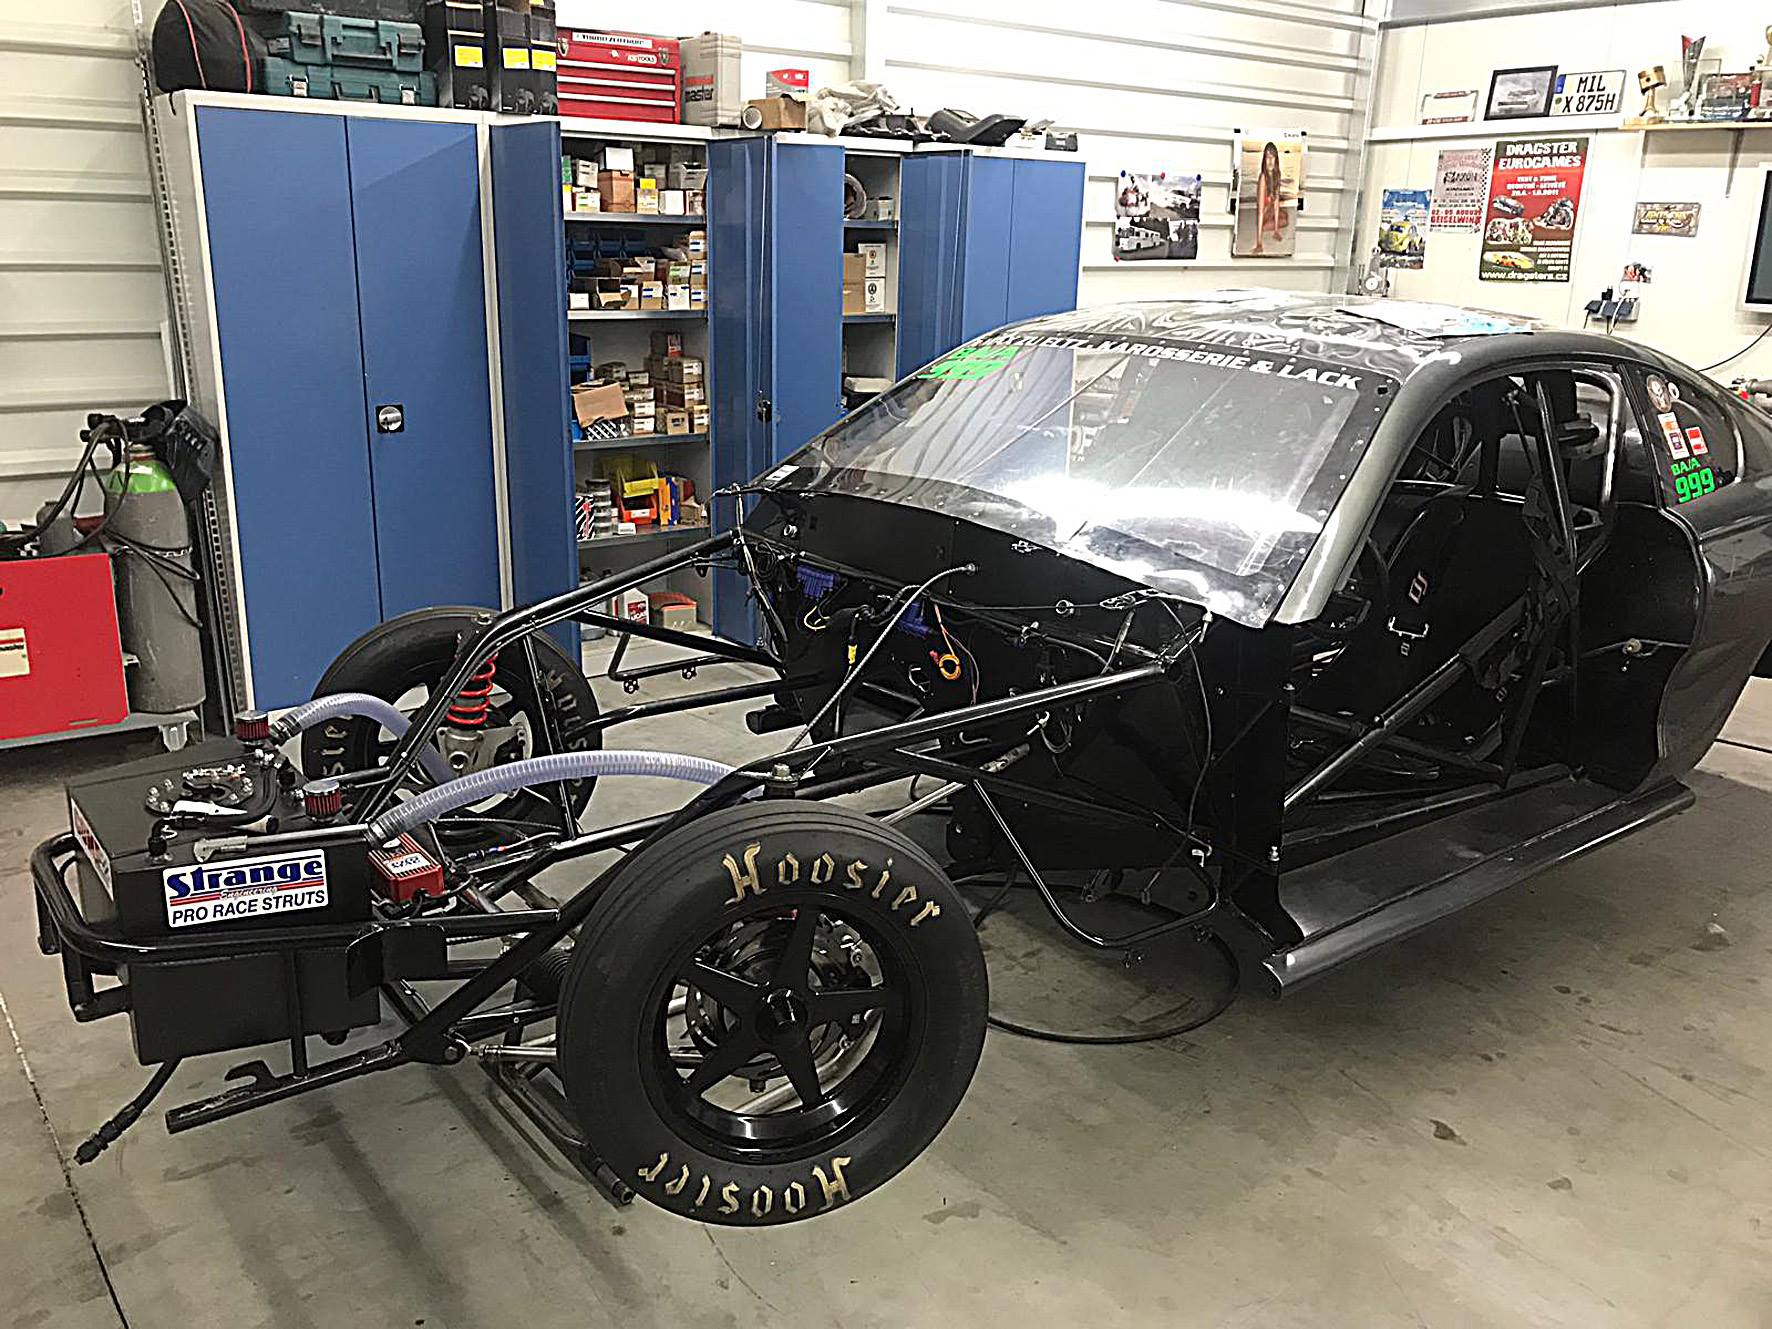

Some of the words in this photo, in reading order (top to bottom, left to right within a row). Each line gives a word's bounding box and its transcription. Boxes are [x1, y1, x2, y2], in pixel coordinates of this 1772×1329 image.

[1576, 75, 1606, 93] MIL
[1562, 96, 1573, 113] X
[1575, 93, 1616, 112] 875H
[1498, 155, 1582, 171] EUROGAMES
[1505, 142, 1578, 156] DRAGSTER
[1481, 270, 1568, 281] www.dragsters.cz
[1098, 340, 1250, 371] KAROSSERIE
[1249, 360, 1275, 375] &
[1276, 364, 1362, 391] LACK
[1675, 467, 1716, 503] 999
[166, 859, 323, 899] Strange
[722, 842, 940, 927] Hoosier
[172, 906, 209, 925] PRO
[212, 898, 259, 919] RACE
[261, 889, 326, 912] STRUTS
[638, 1152, 852, 1218] Hoosier
